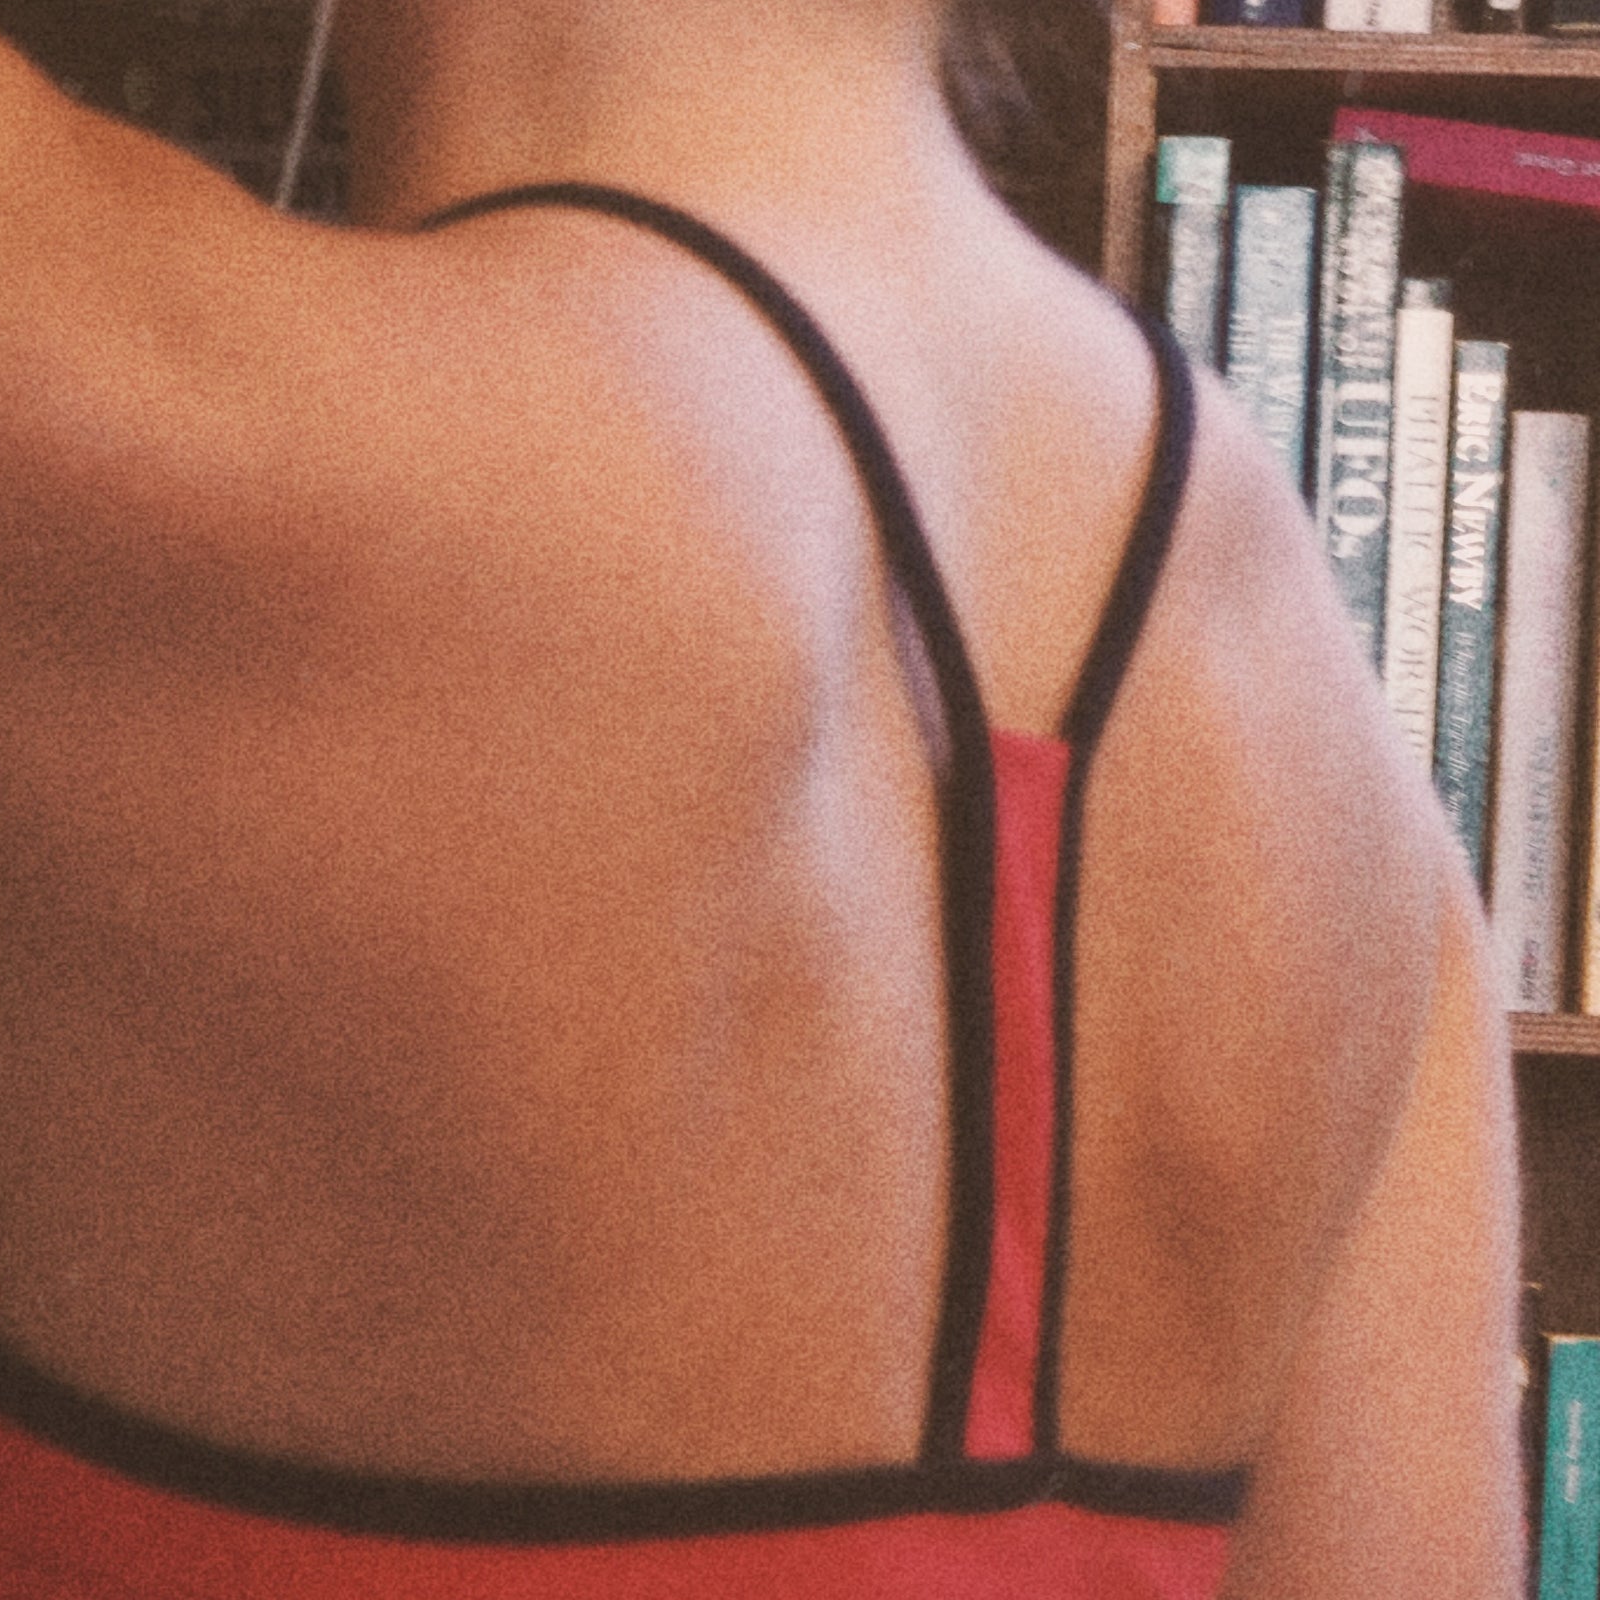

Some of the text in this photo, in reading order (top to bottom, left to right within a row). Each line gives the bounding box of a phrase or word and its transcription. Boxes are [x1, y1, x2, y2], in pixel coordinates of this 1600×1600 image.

[1328, 377, 1392, 560] UFOs
[1451, 371, 1502, 613] ERIC NEWBY
